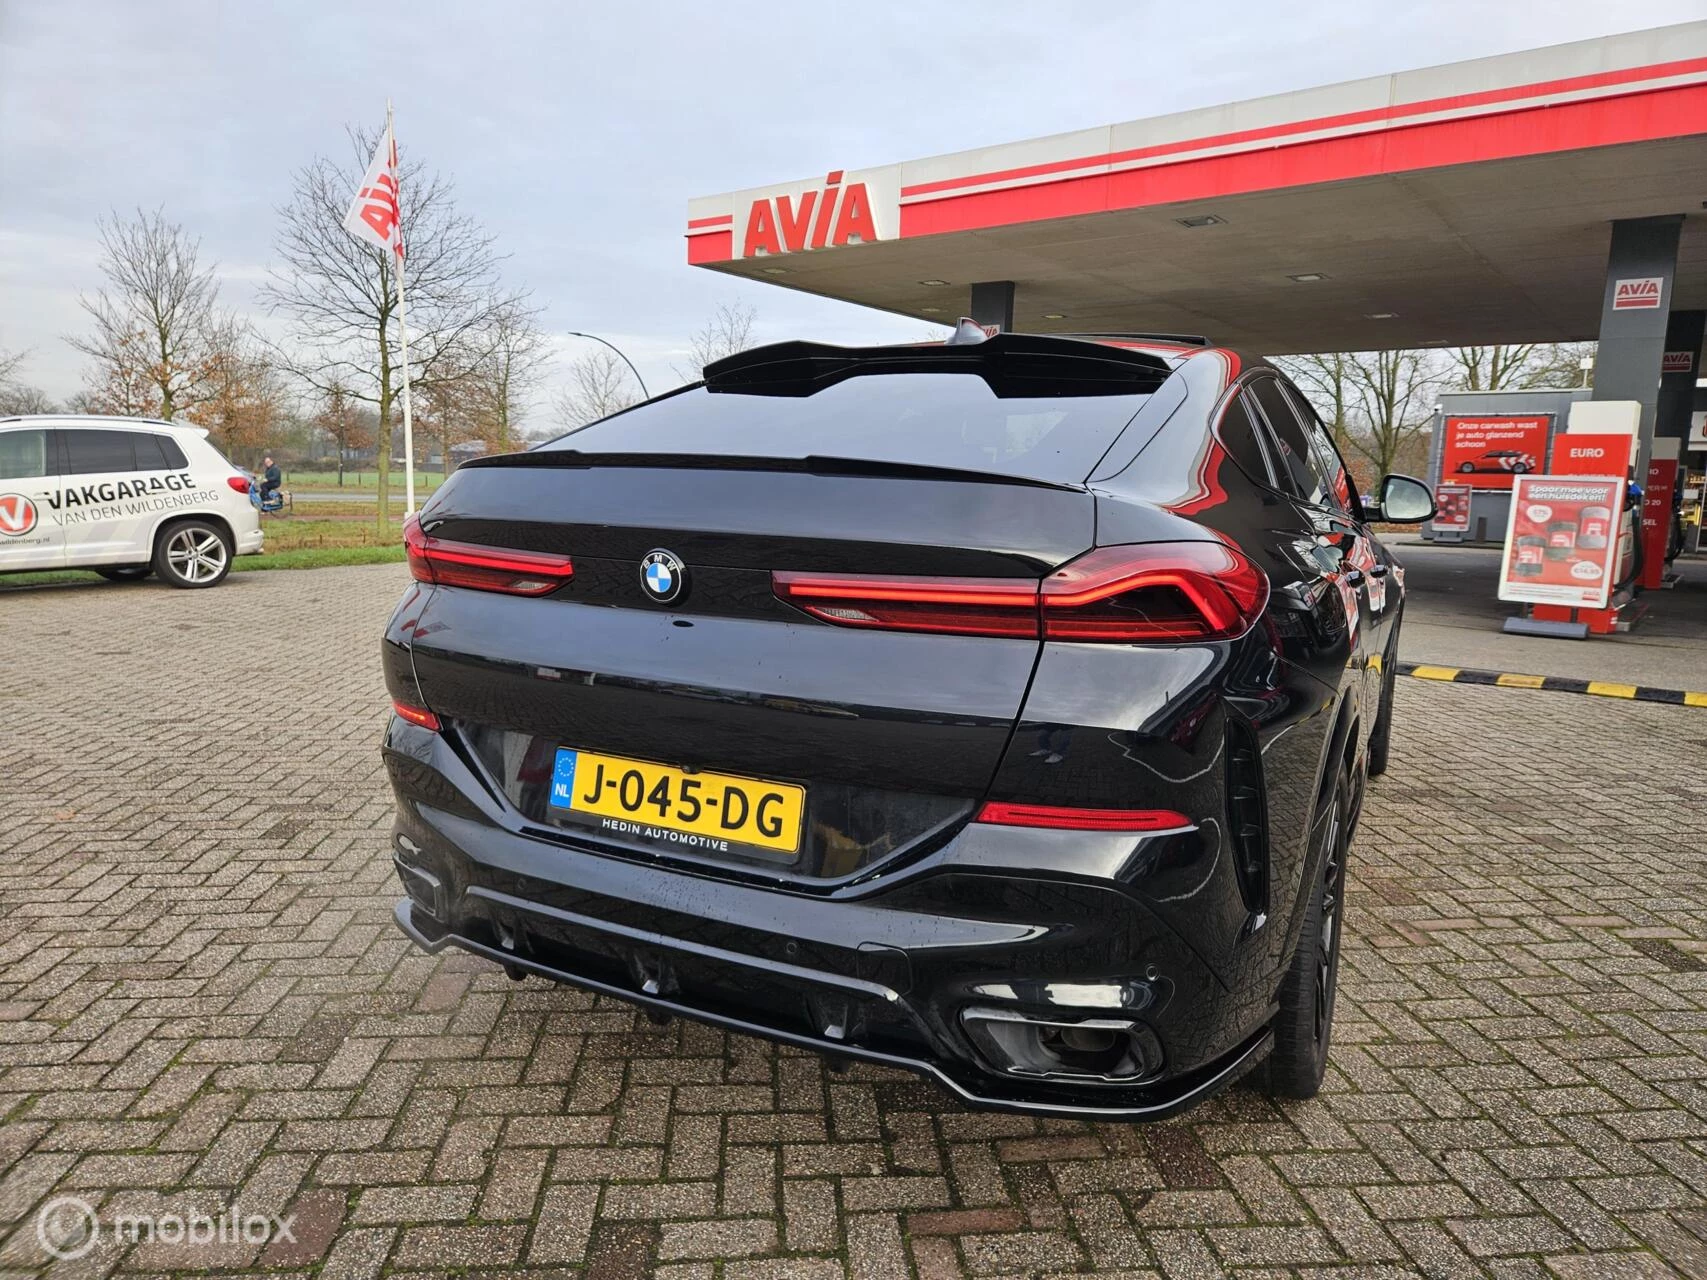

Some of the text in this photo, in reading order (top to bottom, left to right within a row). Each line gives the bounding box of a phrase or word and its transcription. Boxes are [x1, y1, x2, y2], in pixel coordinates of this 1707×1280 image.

[1466, 431, 1484, 439] auto
[1485, 431, 1524, 440] glanzend
[1570, 447, 1604, 458] EURO
[48, 473, 196, 510] VAKGARAGE
[53, 490, 219, 526] VAN DEN WILDENBERG
[643, 554, 677, 571] BMW
[555, 783, 569, 798] NL
[583, 763, 785, 838] J-045-DG
[602, 818, 729, 851] HEDIN AUTOMOTIVE
